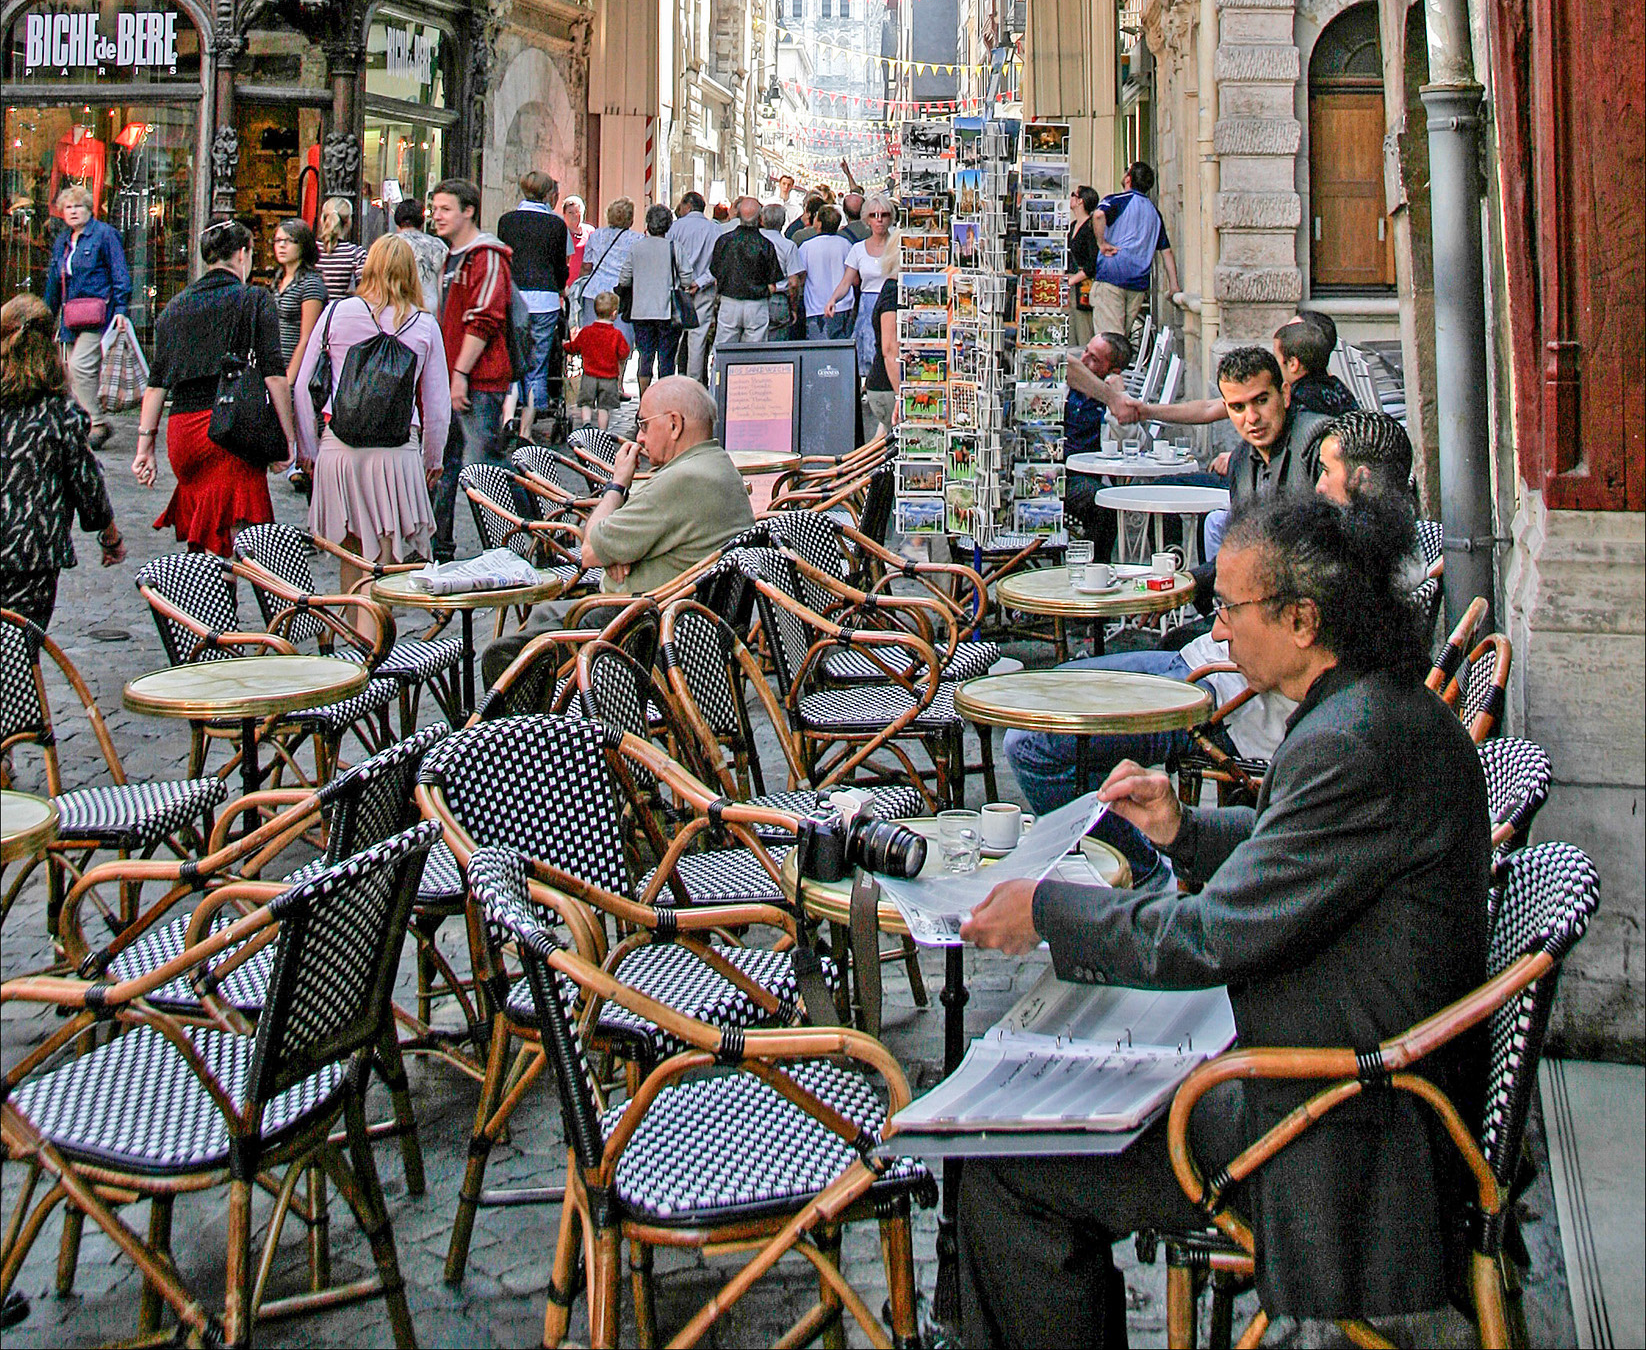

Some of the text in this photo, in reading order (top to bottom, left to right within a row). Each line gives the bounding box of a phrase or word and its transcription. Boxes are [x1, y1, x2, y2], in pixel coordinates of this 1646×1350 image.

[25, 12, 178, 67] BICHE de BERE
[25, 67, 178, 76] PARIS
